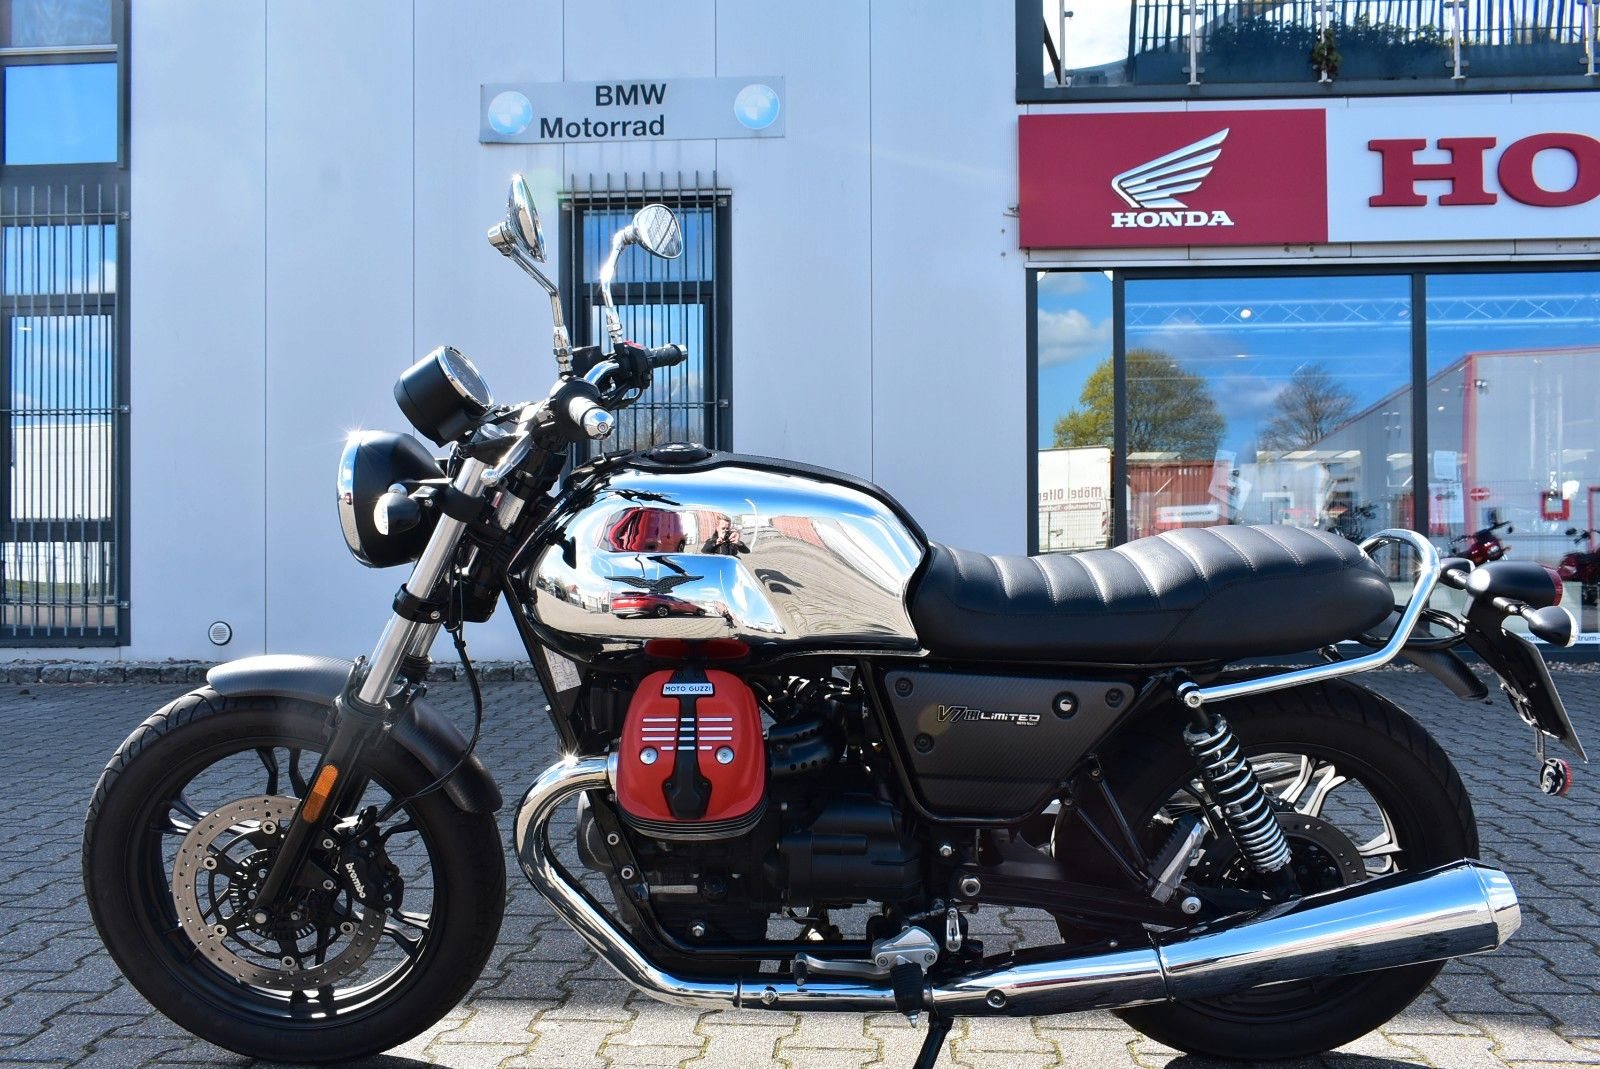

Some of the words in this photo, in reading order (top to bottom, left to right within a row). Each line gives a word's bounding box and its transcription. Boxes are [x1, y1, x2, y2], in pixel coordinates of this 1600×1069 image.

[595, 84, 666, 106] BMW
[540, 115, 665, 139] Motorrad
[1111, 210, 1234, 228] HONDA
[938, 704, 967, 722] V7
[345, 862, 366, 899] brembo
